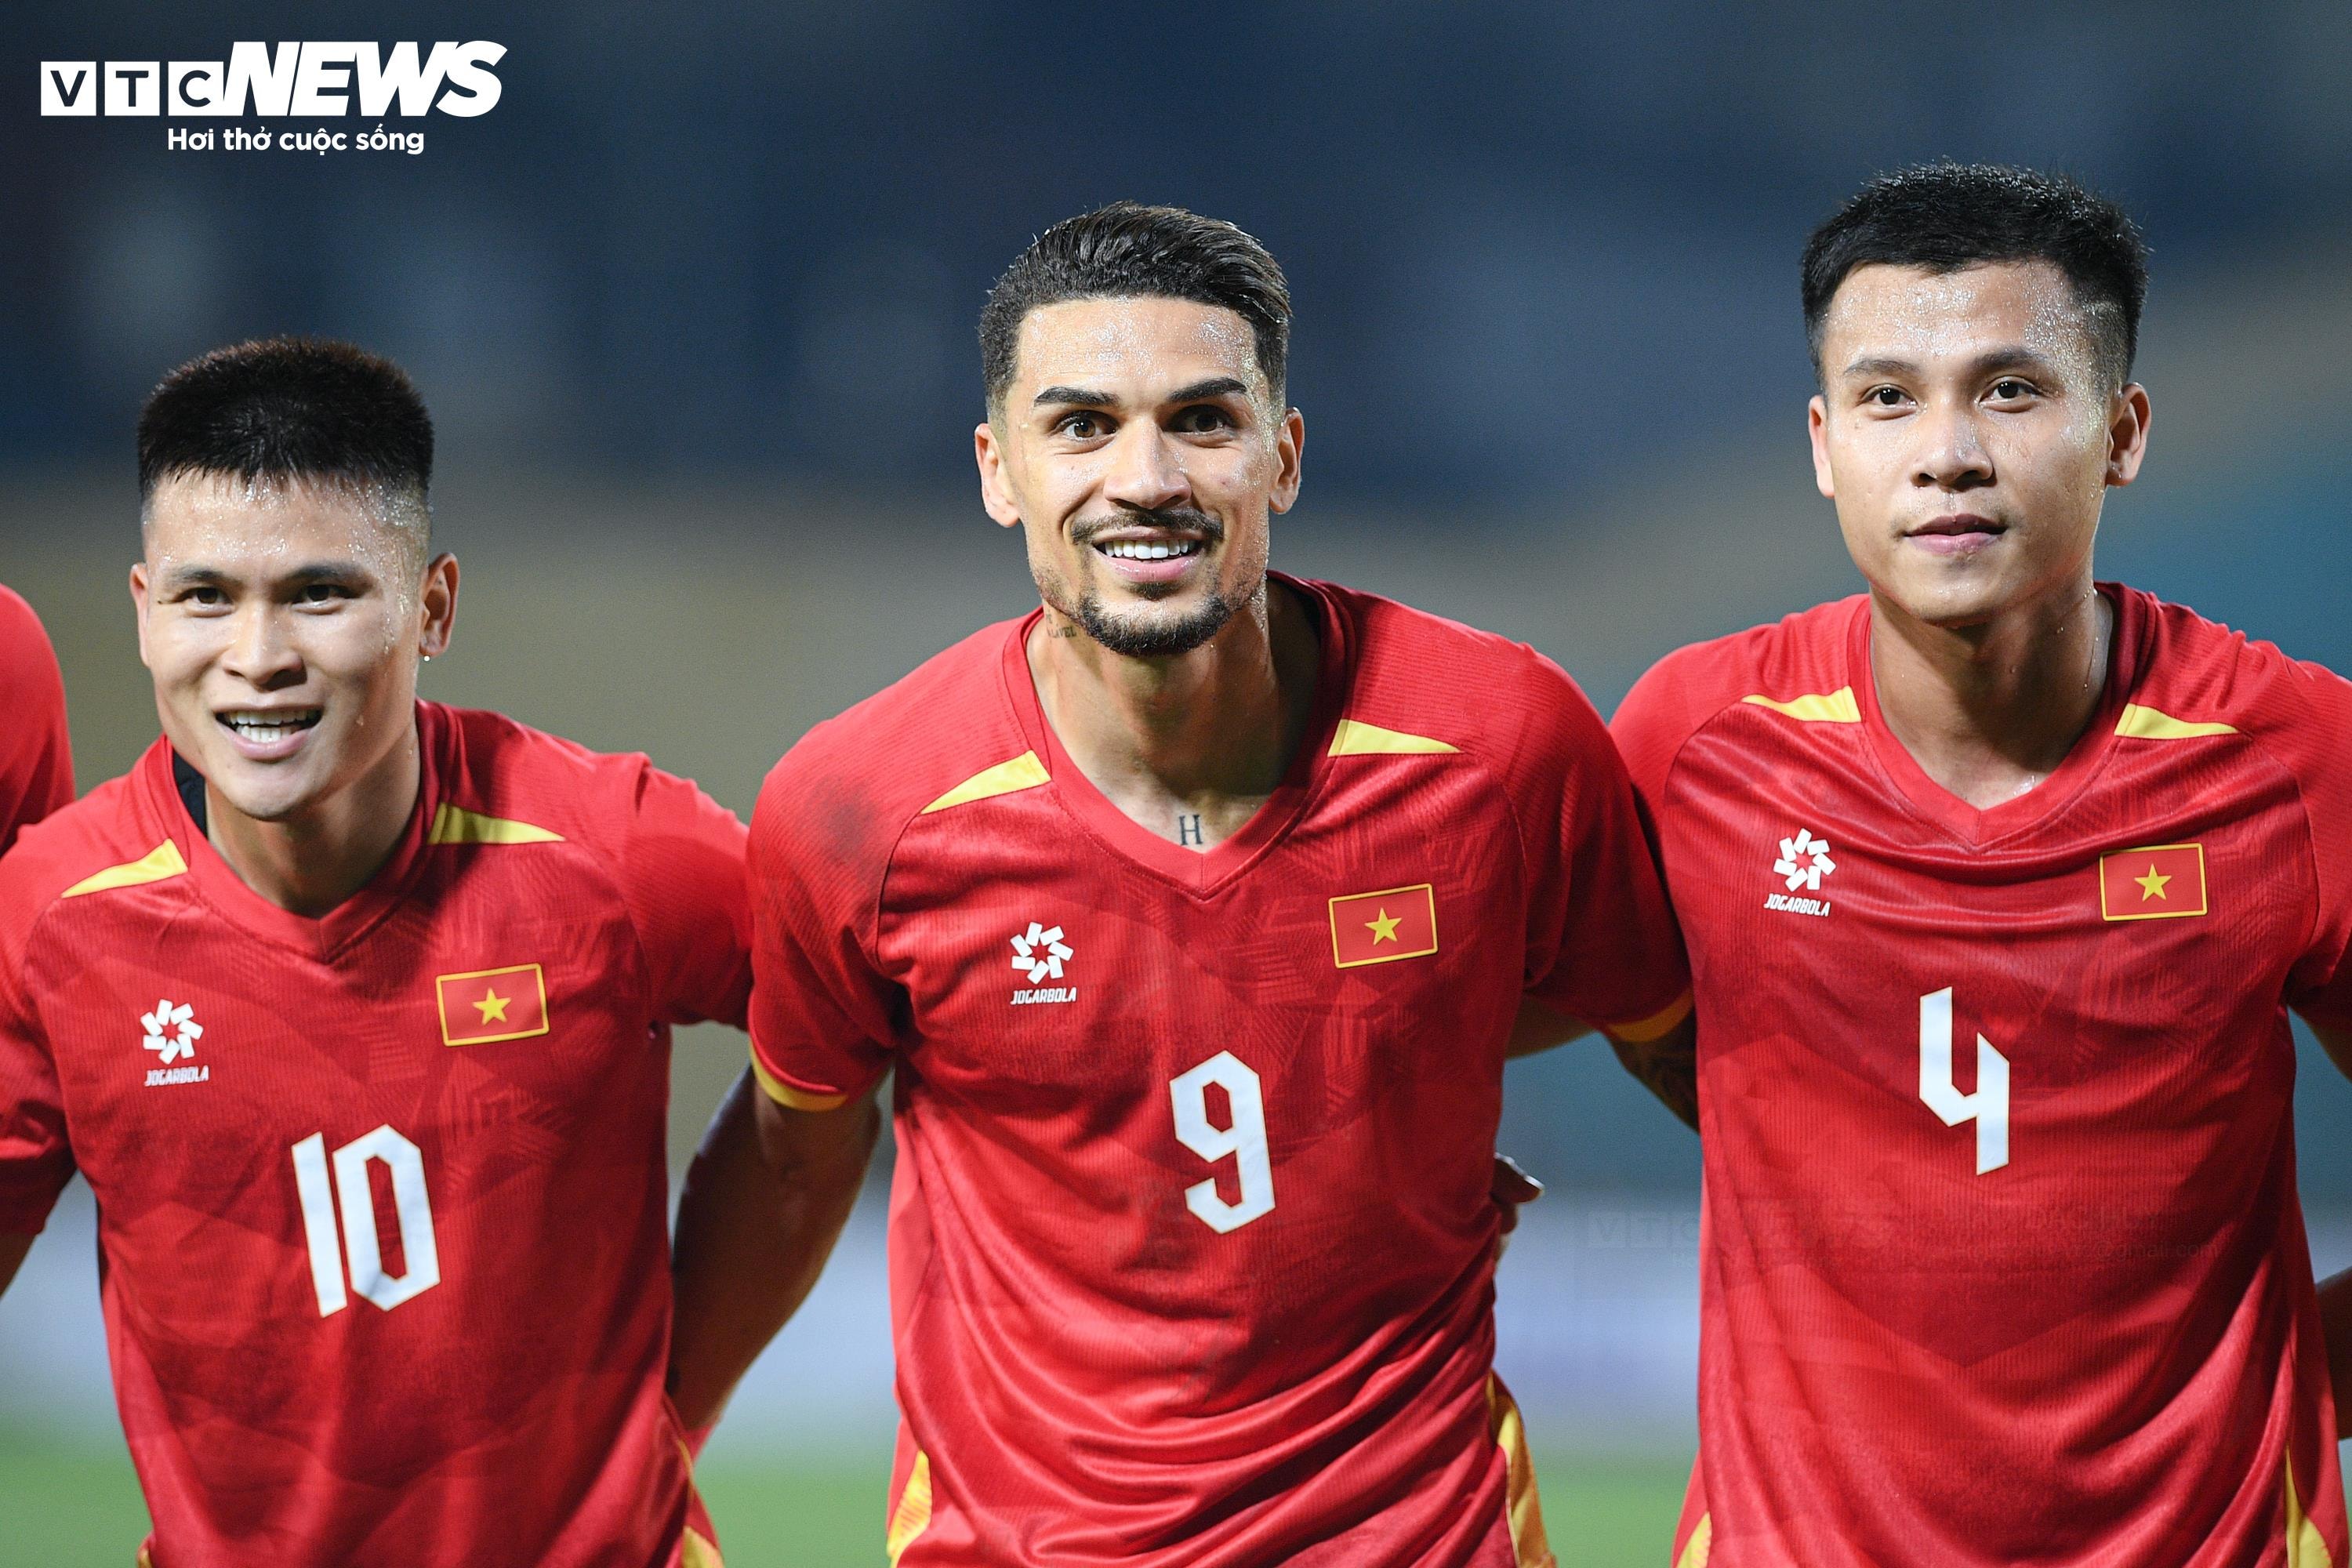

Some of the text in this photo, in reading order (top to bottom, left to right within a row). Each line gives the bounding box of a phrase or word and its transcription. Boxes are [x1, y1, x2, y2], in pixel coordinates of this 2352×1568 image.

[1178, 814, 1203, 846] H
[1763, 892, 1831, 917] JOGARBOLA
[1010, 986, 1077, 1005] JOGARBOLA
[143, 1065, 209, 1087] JOGARBOLA
[1918, 985, 2010, 1176] 4
[1169, 1049, 1276, 1234] 9
[291, 1123, 441, 1318] 10
